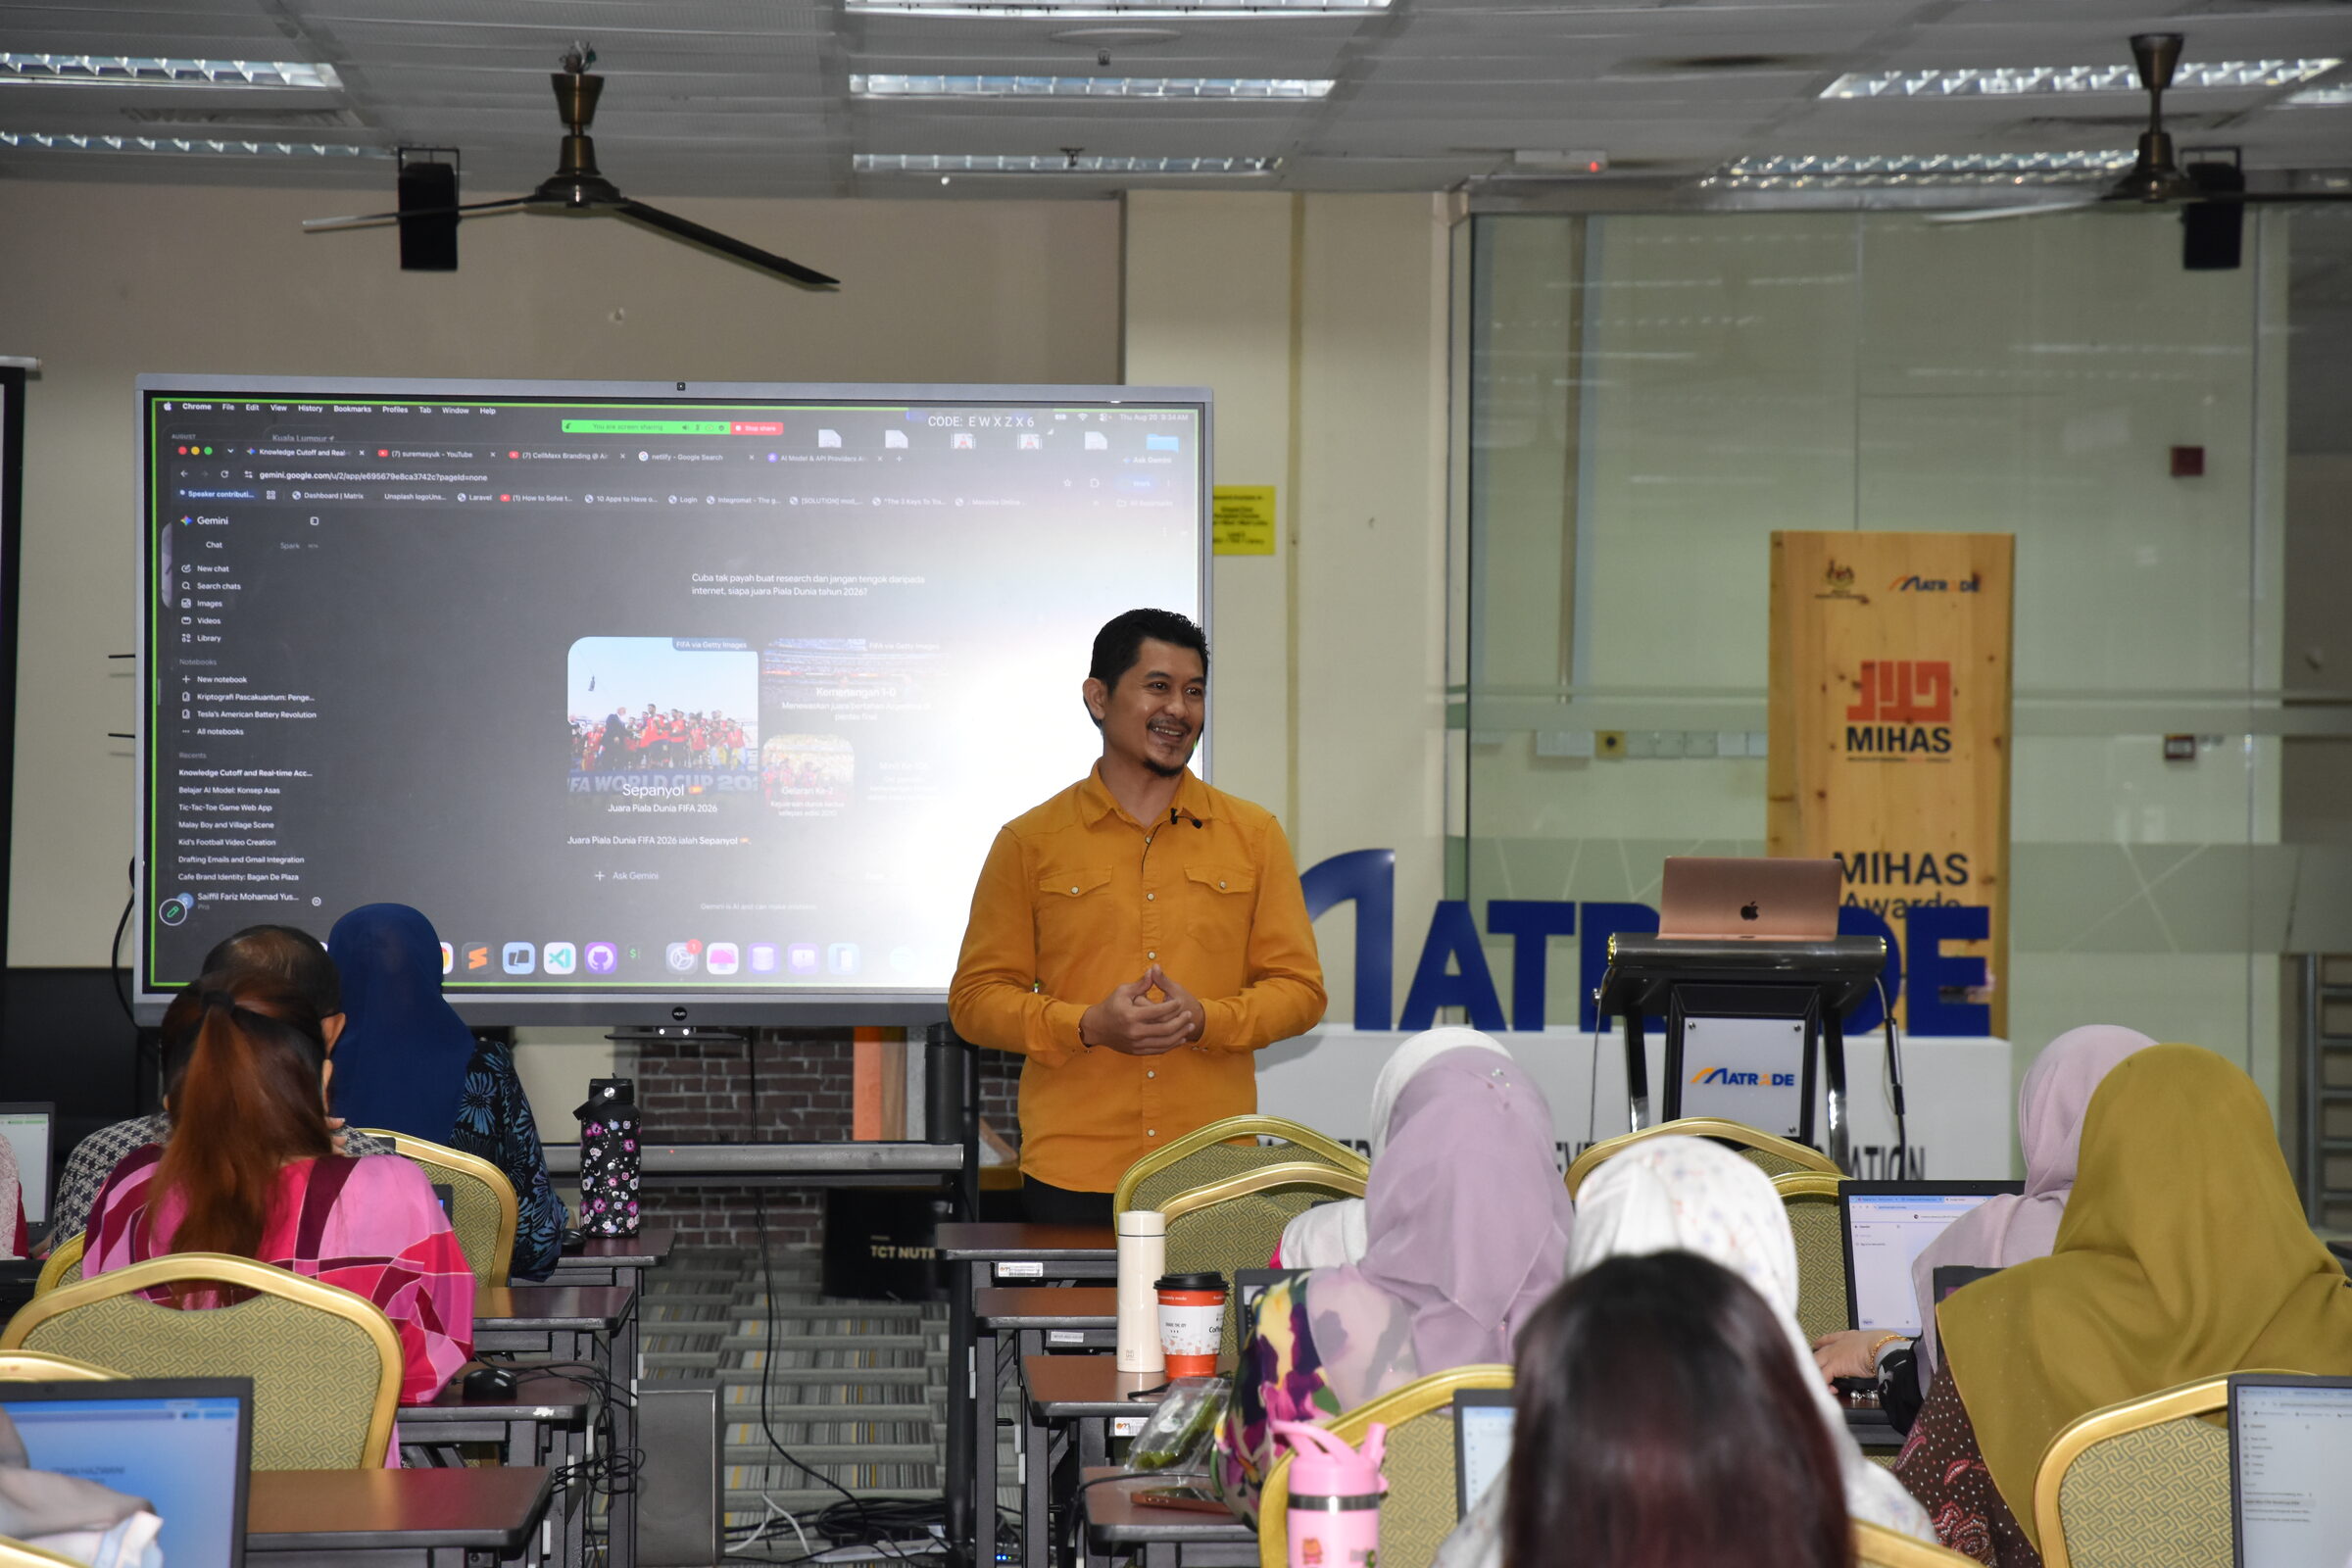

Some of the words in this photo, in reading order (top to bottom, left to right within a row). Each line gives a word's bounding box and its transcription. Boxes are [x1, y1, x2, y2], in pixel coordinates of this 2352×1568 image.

[298, 405, 323, 414] History
[479, 407, 497, 416] Help
[928, 416, 963, 427] CODE:
[968, 416, 976, 427] E
[979, 416, 991, 427] W
[993, 416, 1003, 427] X
[1004, 416, 1013, 427] Z
[1015, 416, 1025, 427] X
[1027, 416, 1035, 428] 6
[391, 450, 402, 459] (7)
[196, 516, 229, 525] Gemini
[279, 542, 301, 551] Spark
[692, 573, 714, 582] Cuba
[715, 573, 729, 582] tak
[729, 573, 755, 584] payah
[756, 574, 775, 583] buat
[775, 574, 812, 583] research
[812, 574, 829, 583] dan
[829, 576, 858, 585] jangan
[858, 574, 888, 585] tengok
[888, 575, 925, 585] daripada
[727, 588, 750, 597] siapa
[197, 600, 223, 609] Images
[197, 635, 221, 644] Library
[703, 641, 722, 650] Getty
[722, 641, 748, 650] Images
[254, 711, 280, 720] Battery
[1845, 727, 1952, 754] MIHAS
[178, 769, 220, 778] Knowledge
[680, 775, 714, 792] CUP
[178, 787, 203, 796] Belajar
[236, 787, 264, 796] Konsep
[621, 784, 685, 799] Sepanyol
[257, 805, 272, 813] App
[607, 804, 631, 812] Juara
[631, 804, 652, 812] Piala
[653, 804, 677, 812] Dunia
[678, 804, 696, 812] FIFA
[696, 804, 718, 812] 2026
[178, 821, 199, 830] Malay
[200, 821, 214, 830] Boy
[228, 821, 253, 830] Village
[566, 836, 591, 845] Juara
[591, 836, 612, 845] Piala
[699, 837, 738, 847] Sepanyol
[1833, 853, 1970, 886] MIHAS
[246, 873, 269, 882] Bagan
[1690, 1067, 1795, 1086] MATRADE
[870, 1245, 897, 1258] TCT
